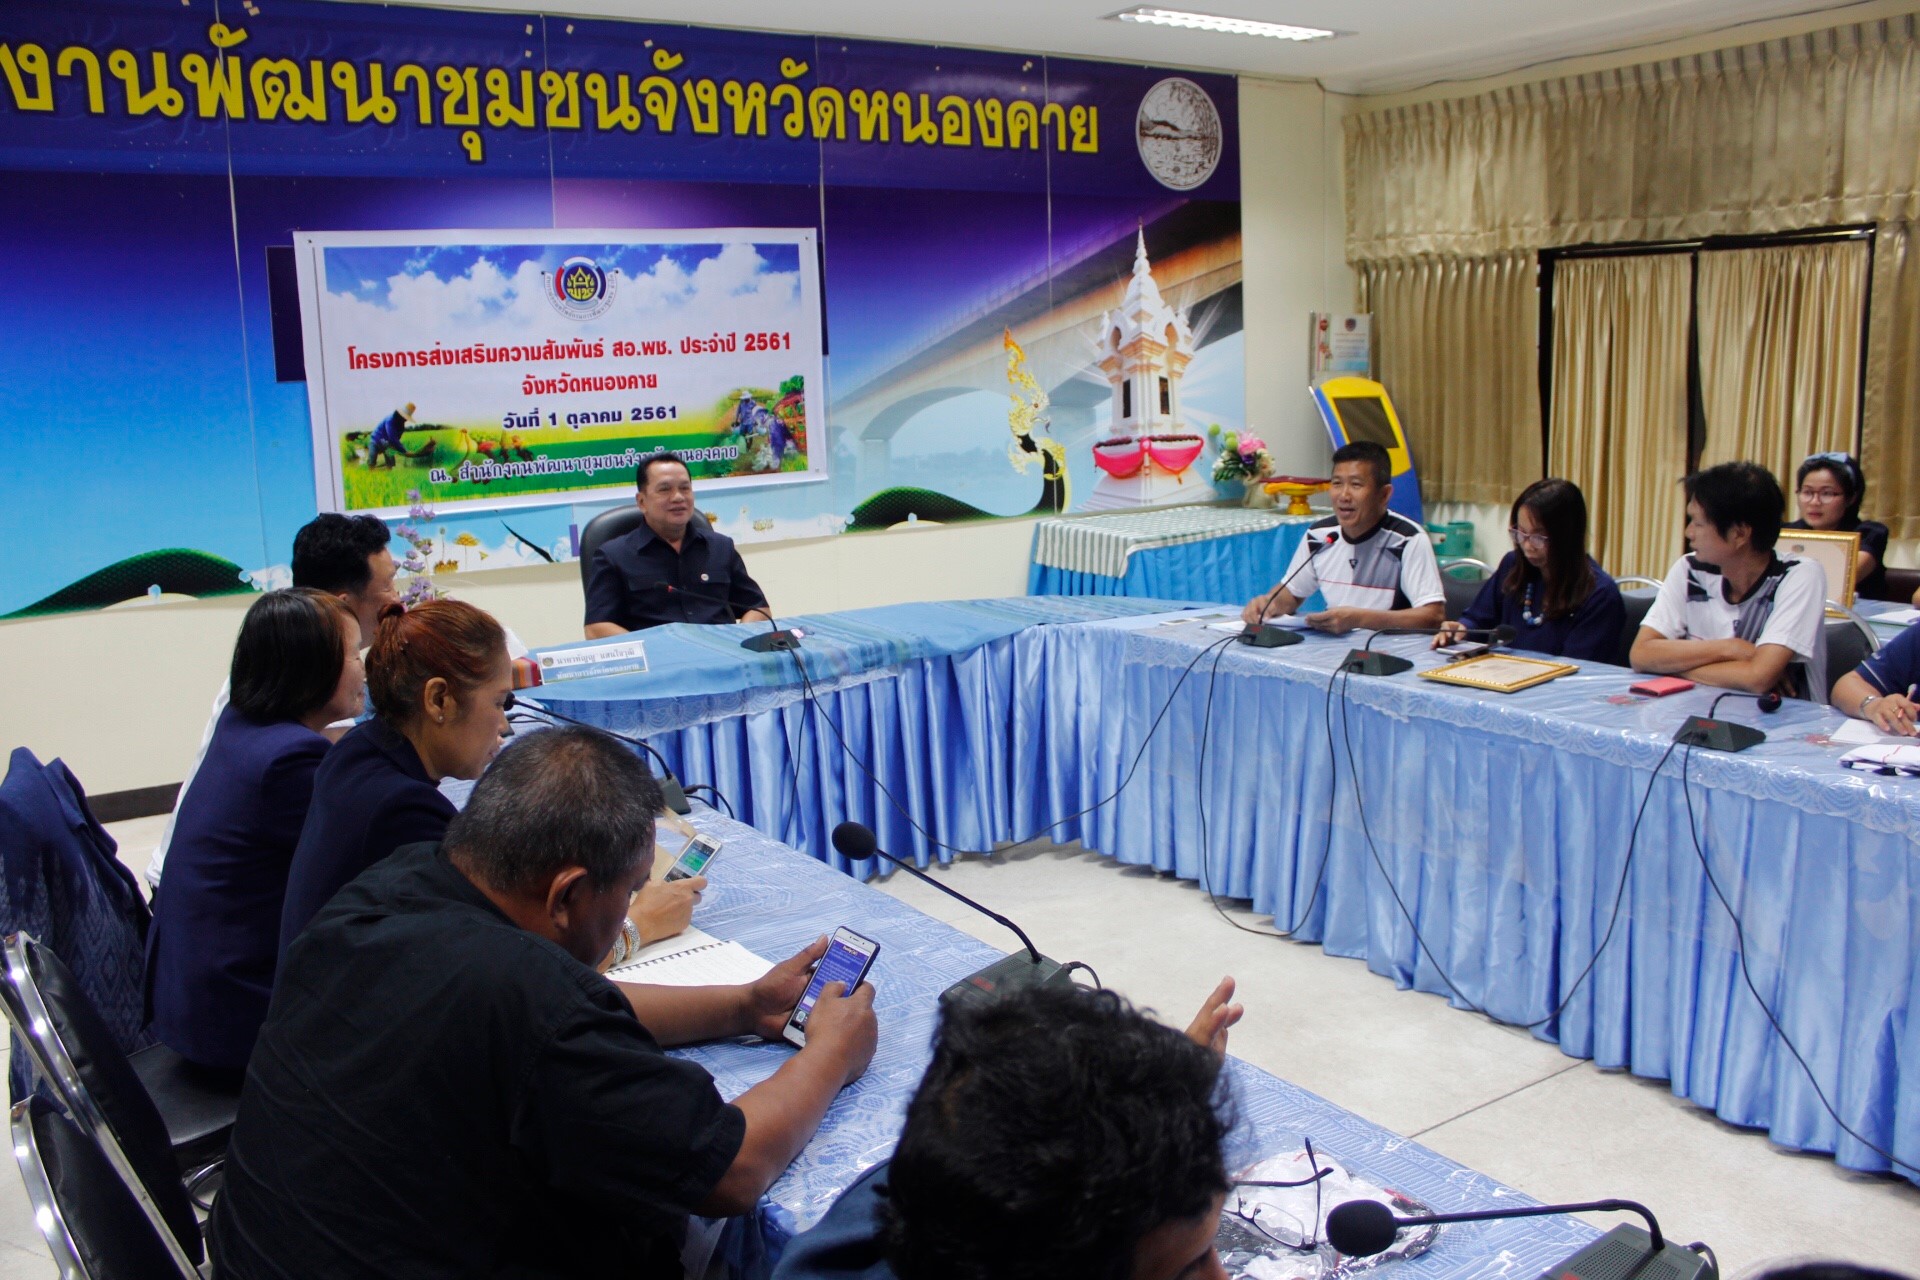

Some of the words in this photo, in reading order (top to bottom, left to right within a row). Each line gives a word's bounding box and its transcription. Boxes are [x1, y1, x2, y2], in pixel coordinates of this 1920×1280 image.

[347, 337, 604, 370] โครงการส่งเสริมความสัมพันธ์
[612, 338, 672, 357] สอ.พช.
[680, 332, 736, 355] ประจำปี
[744, 332, 790, 351] 2561
[522, 372, 657, 396] จังหวัดหนองคาย
[503, 408, 540, 429] วันที่
[548, 412, 557, 425] 1
[566, 410, 622, 429] ตุลาคม
[631, 406, 677, 421] 2561
